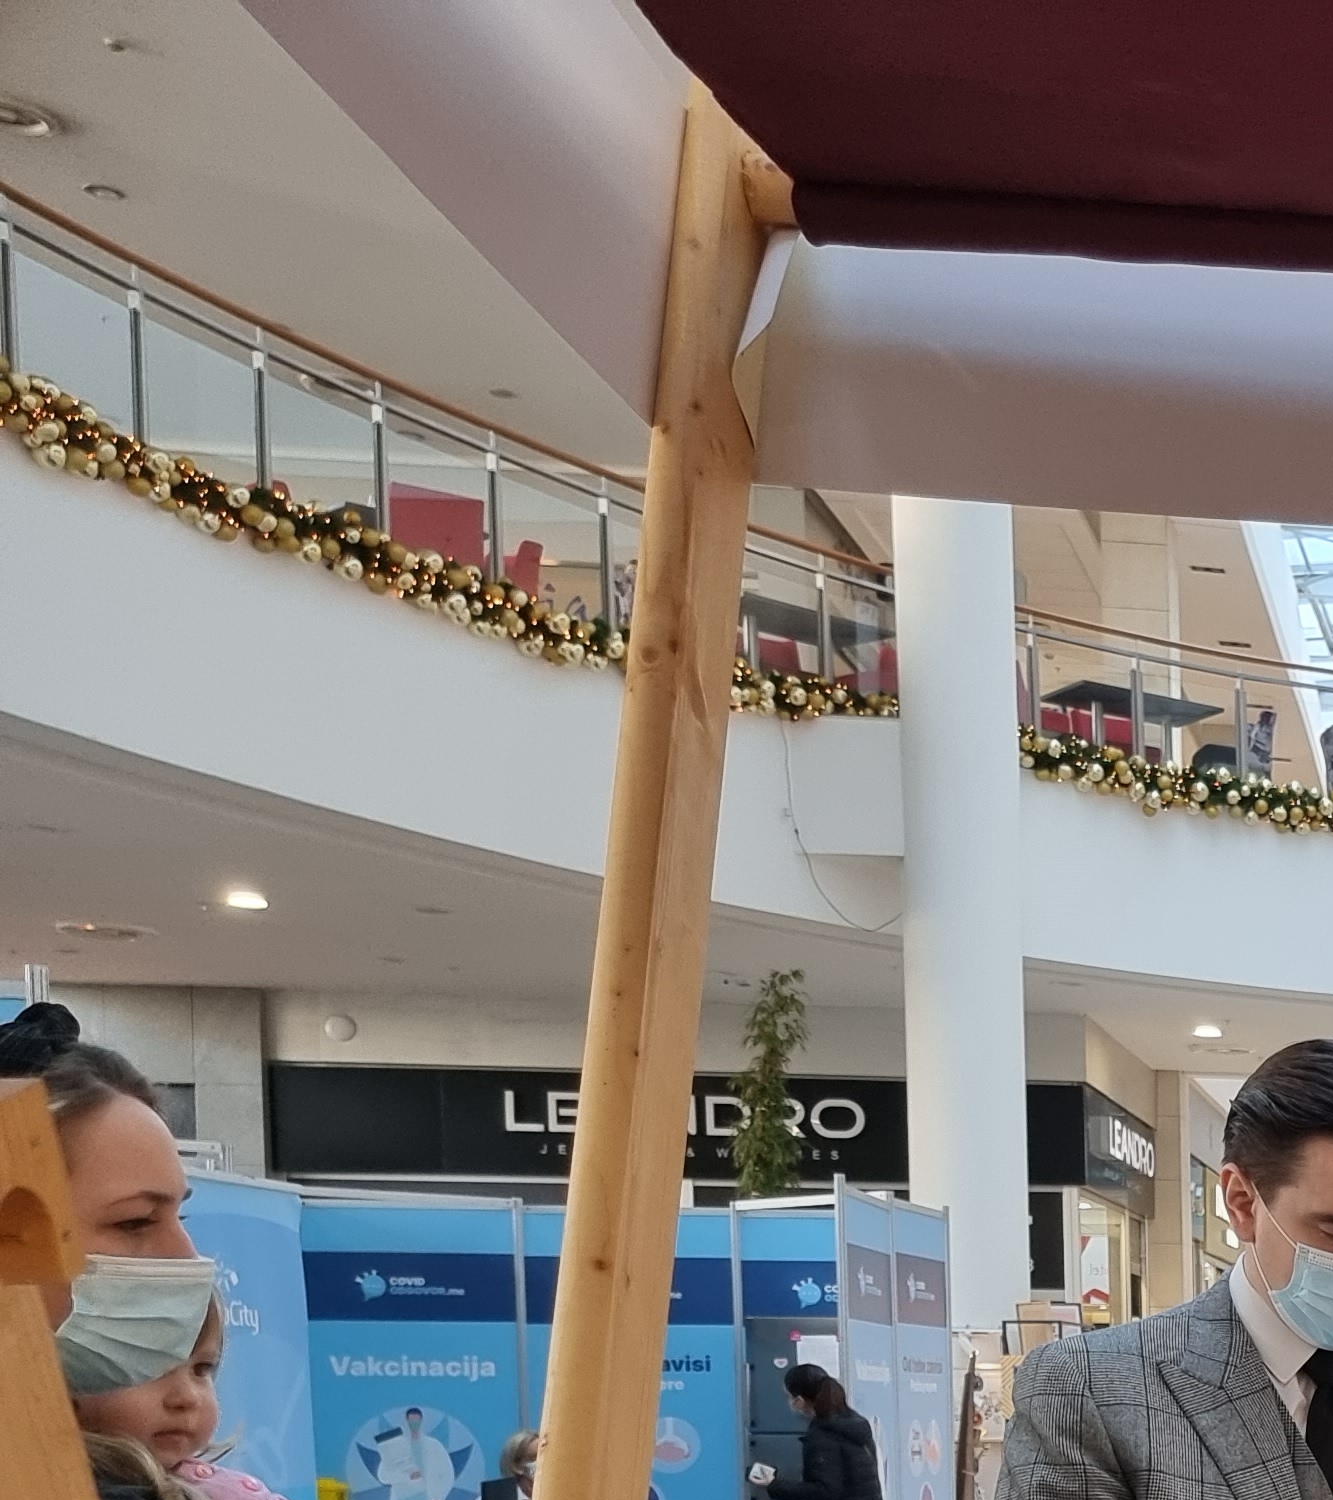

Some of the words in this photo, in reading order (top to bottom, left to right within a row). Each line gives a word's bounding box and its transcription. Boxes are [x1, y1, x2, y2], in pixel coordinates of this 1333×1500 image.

[504, 1089, 866, 1139] LEDRO
[1108, 1115, 1155, 1178] LEANDRO
[389, 1276, 426, 1287] COVID
[328, 1354, 497, 1383] Vakcinacija
[662, 1354, 712, 1373] avisi
